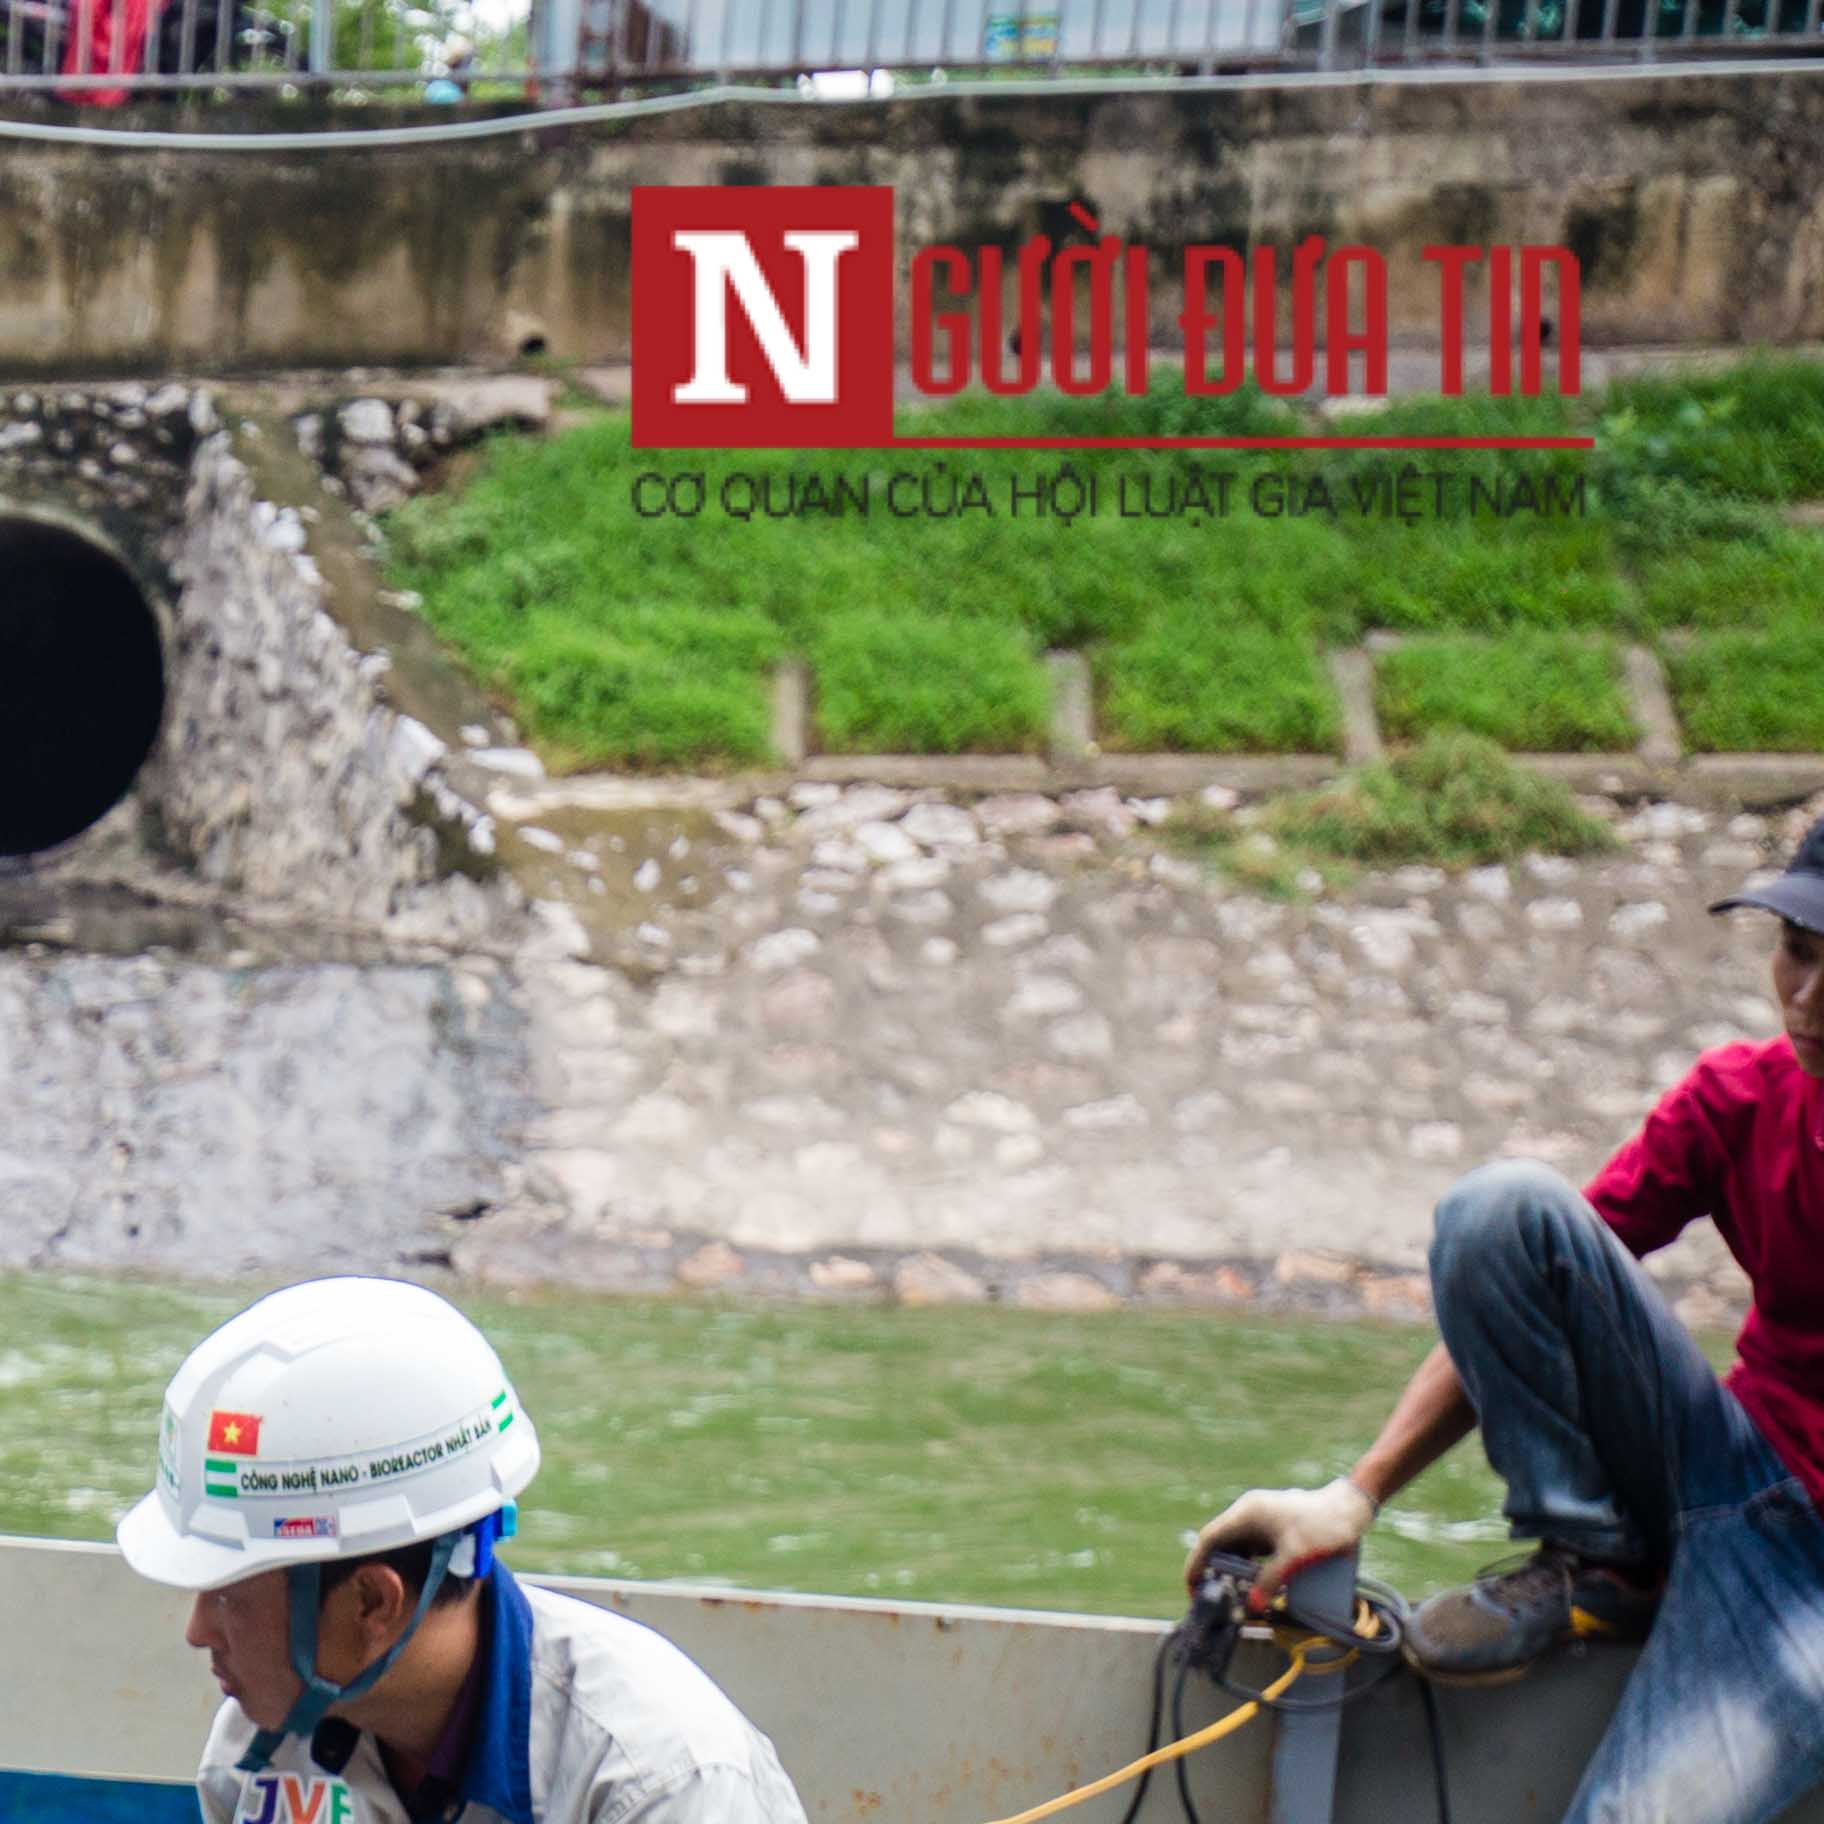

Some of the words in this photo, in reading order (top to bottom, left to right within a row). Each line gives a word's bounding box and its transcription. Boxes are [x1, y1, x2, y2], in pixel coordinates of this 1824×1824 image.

[241, 1471, 278, 1490] CÔNG
[282, 1470, 317, 1494] NGHỆ
[321, 1466, 359, 1486] NANO
[370, 1445, 443, 1478] BIOREACTOR
